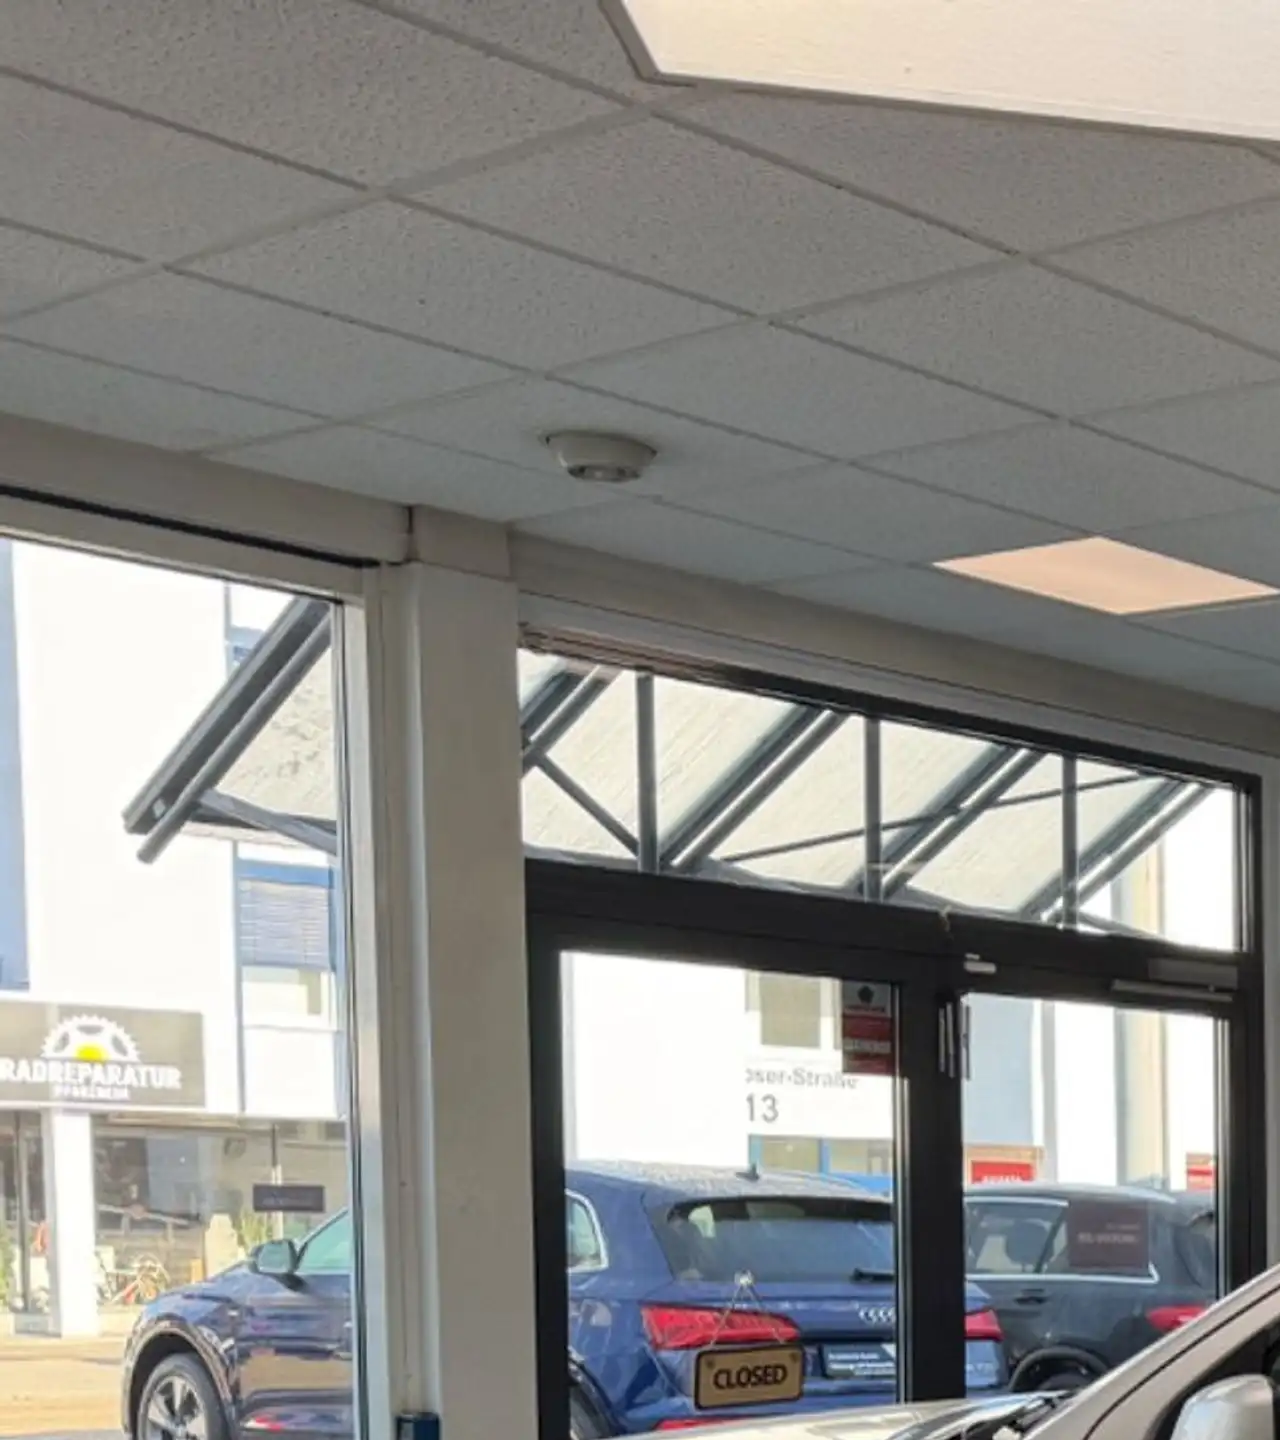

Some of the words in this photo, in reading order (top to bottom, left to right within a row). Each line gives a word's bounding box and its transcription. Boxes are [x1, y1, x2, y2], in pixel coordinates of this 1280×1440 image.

[0, 1057, 182, 1089] RADREPARATUR
[746, 1093, 779, 1123] 13
[713, 1363, 788, 1390] CLOSED
